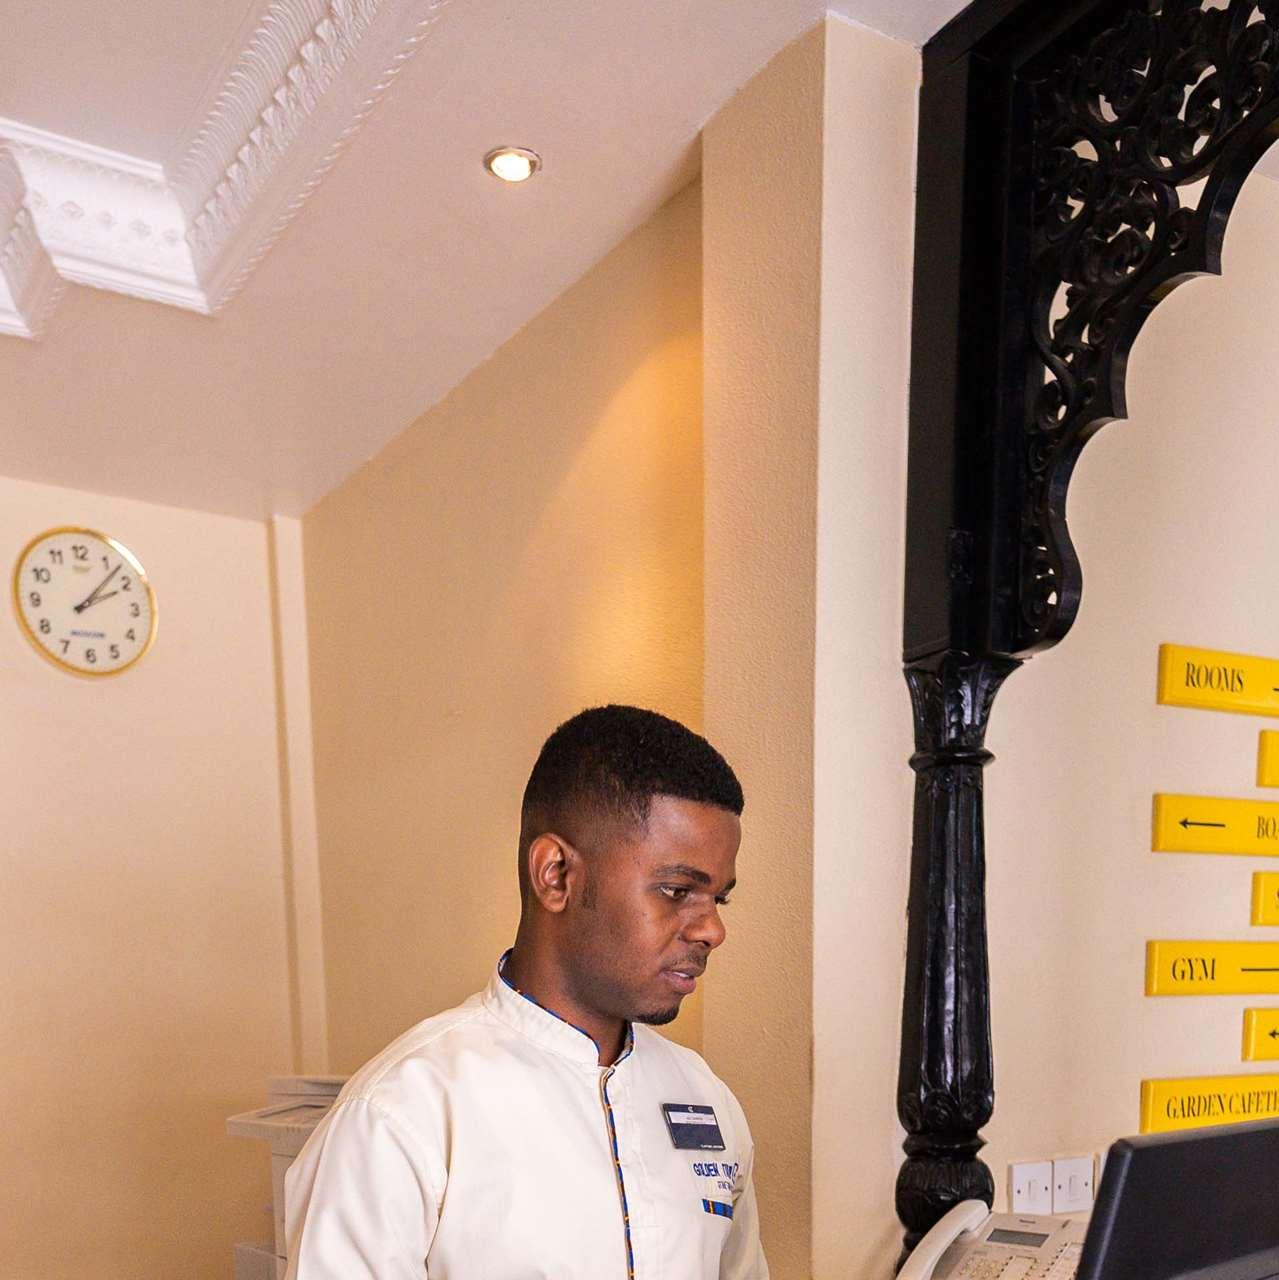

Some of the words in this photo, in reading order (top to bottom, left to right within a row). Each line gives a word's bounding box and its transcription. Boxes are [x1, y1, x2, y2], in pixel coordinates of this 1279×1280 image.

[49, 549, 63, 564] 11
[71, 545, 88, 561] 12
[102, 555, 109, 570] 1
[32, 567, 51, 583] 10
[121, 575, 131, 591] 2
[29, 591, 41, 608] 9
[130, 602, 140, 618] 3
[39, 618, 51, 634] 8
[125, 628, 136, 641] 4
[59, 639, 71, 654] 7
[109, 644, 120, 659] 5
[85, 648, 97, 664] 6
[1185, 661, 1245, 694] ROOMS
[1171, 957, 1217, 981] GYM
[1166, 1093, 1227, 1119] GARDEN
